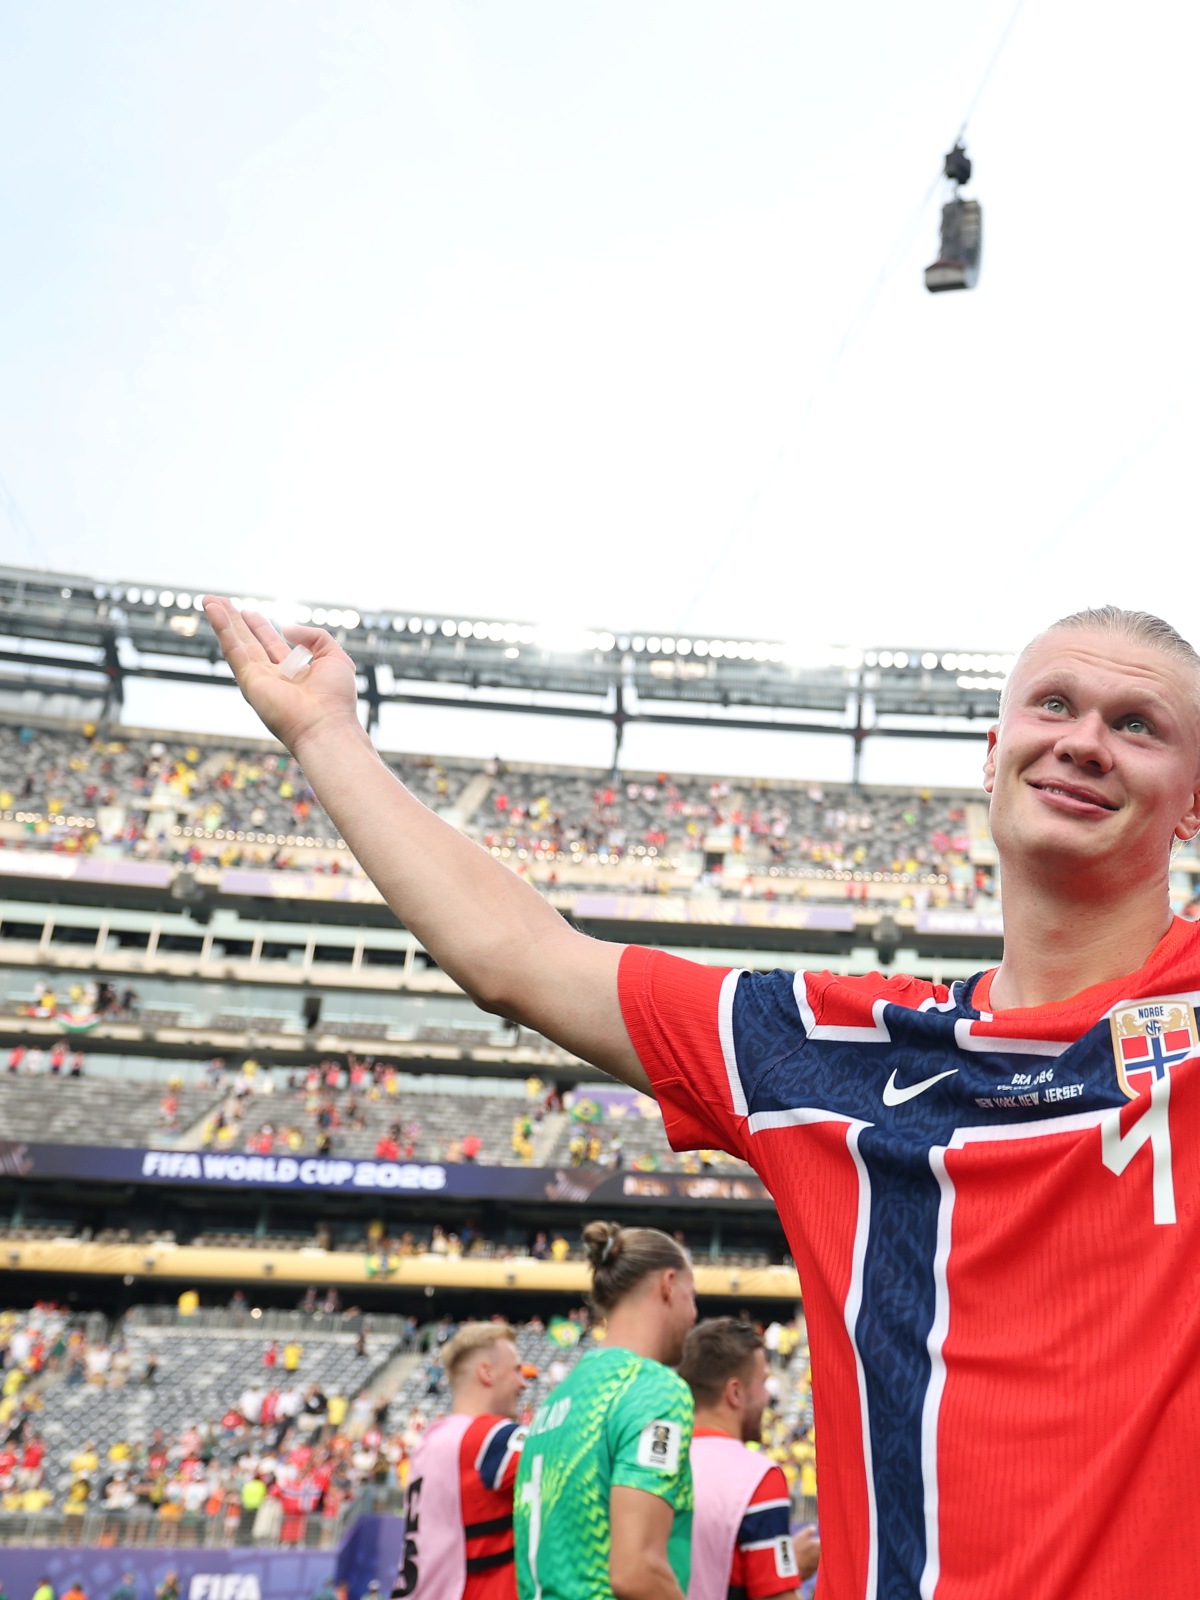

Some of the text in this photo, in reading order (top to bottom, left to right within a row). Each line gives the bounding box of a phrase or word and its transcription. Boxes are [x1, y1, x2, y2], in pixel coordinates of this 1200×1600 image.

[1138, 1006, 1164, 1019] NORGE
[1011, 1073, 1032, 1086] BRA
[975, 1097, 995, 1109] NEW
[993, 1096, 1019, 1108] YORK
[1018, 1091, 1039, 1107] NEW
[1043, 1083, 1084, 1103] JERSEY
[142, 1151, 448, 1190] FIFA WORLD CUP 2026
[188, 1573, 262, 1600] FIFA
